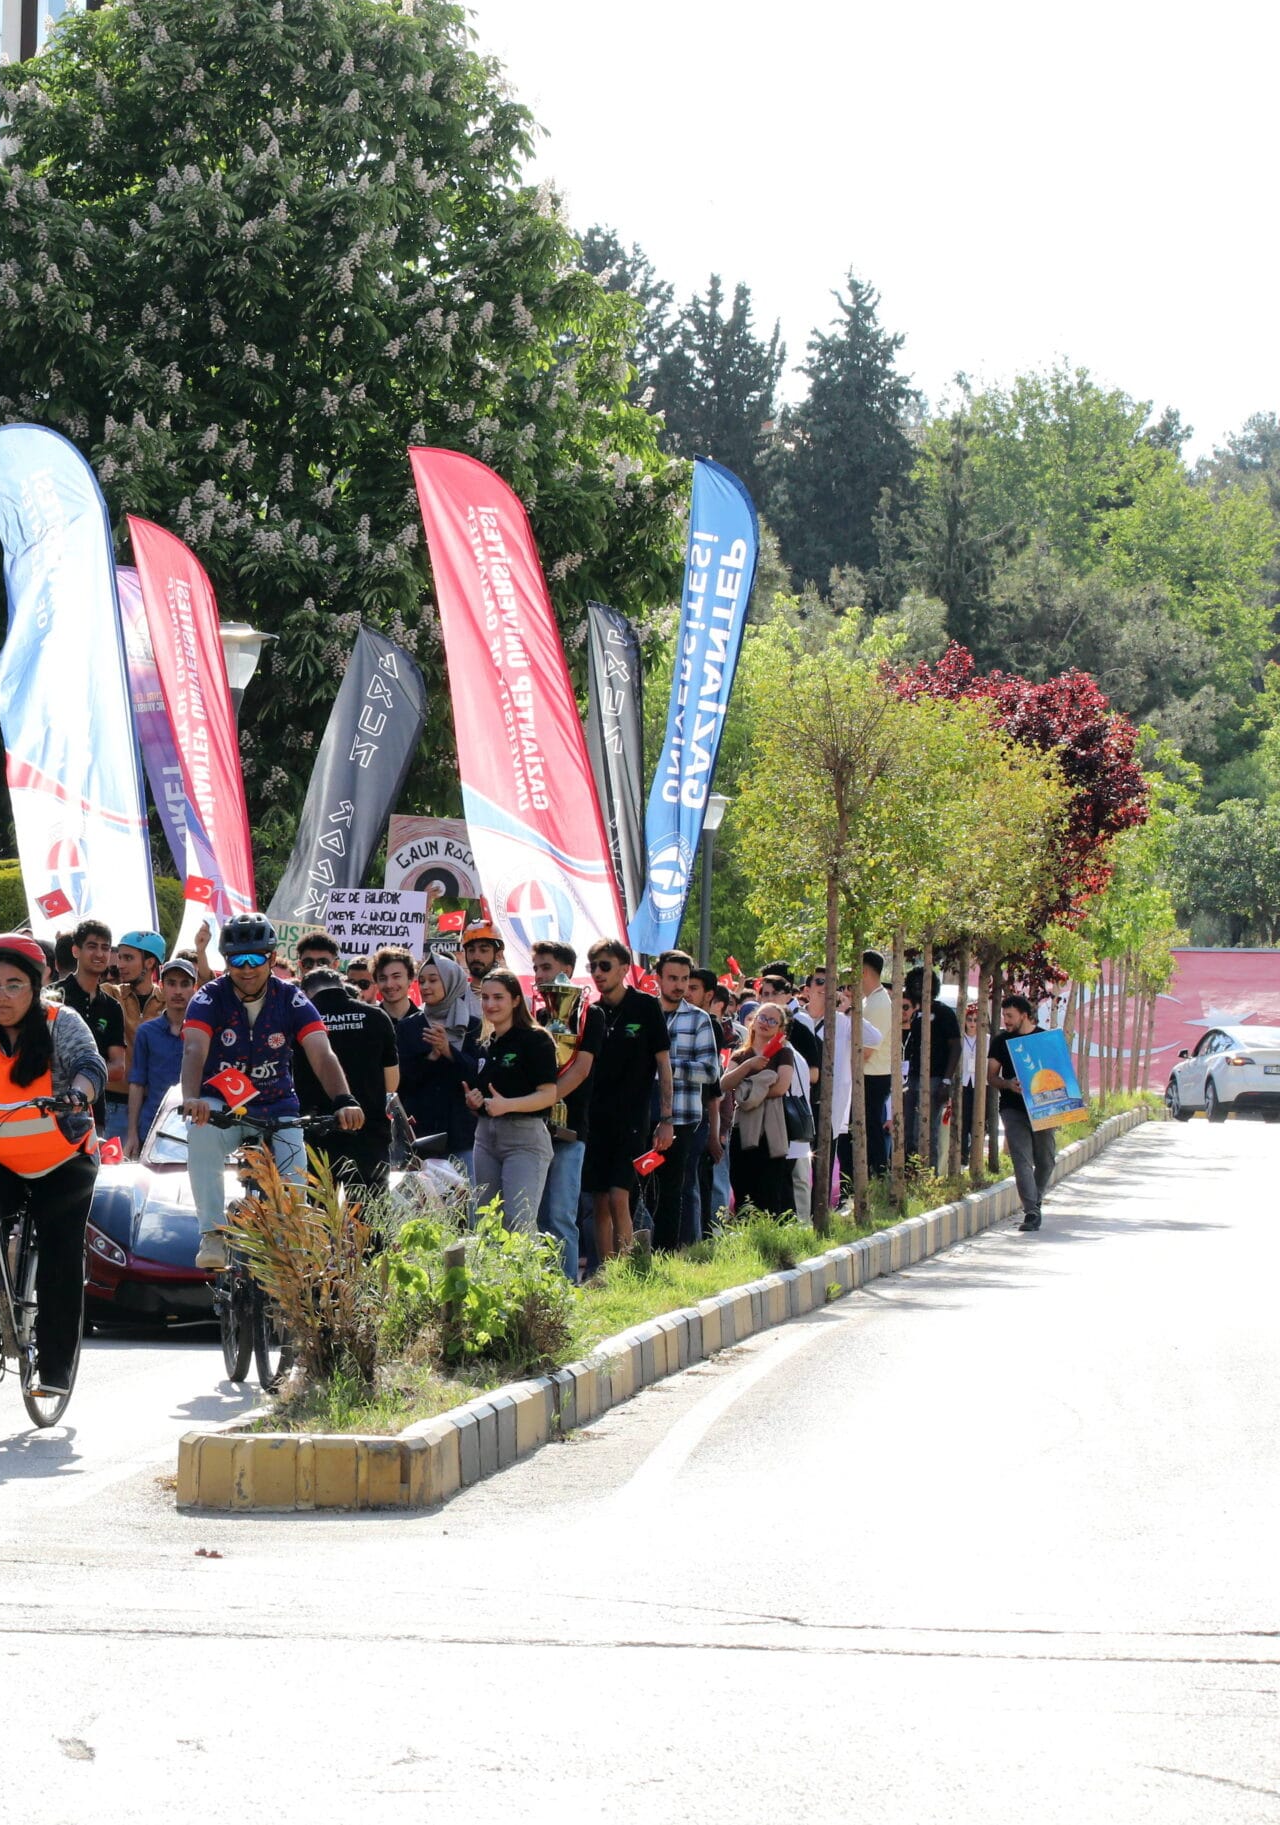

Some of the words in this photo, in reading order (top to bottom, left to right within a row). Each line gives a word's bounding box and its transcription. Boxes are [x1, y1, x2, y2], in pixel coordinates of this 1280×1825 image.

[348, 891, 360, 904] DE
[327, 910, 356, 921] OKEYE
[320, 1013, 366, 1023] ZİANTEP
[325, 1021, 364, 1032] ERSİTESİ
